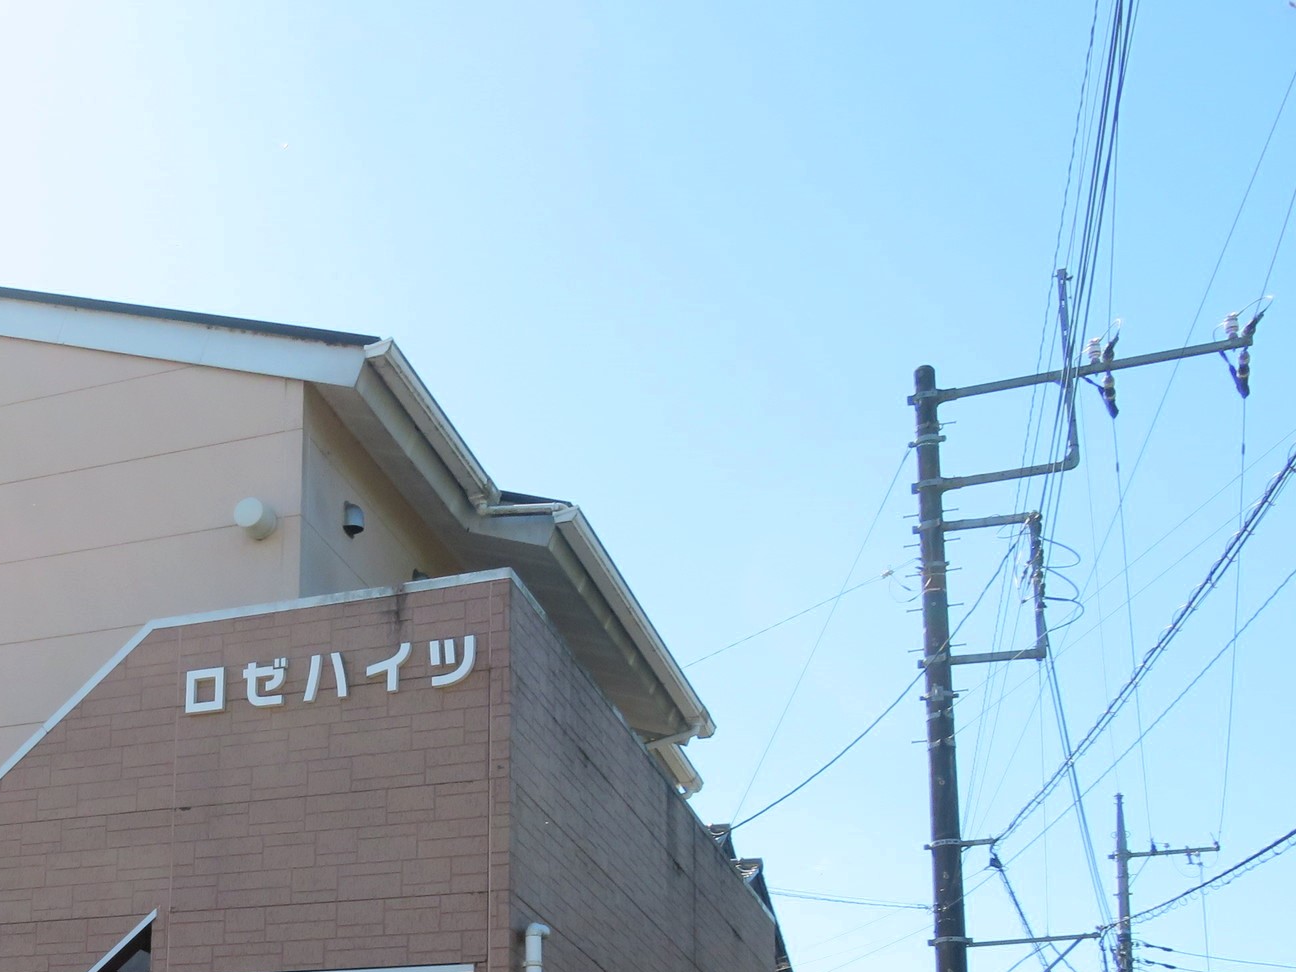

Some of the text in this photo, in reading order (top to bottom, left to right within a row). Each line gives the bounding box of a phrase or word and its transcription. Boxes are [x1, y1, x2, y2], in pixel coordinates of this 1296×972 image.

[184, 634, 476, 714] ロゼハイツ
